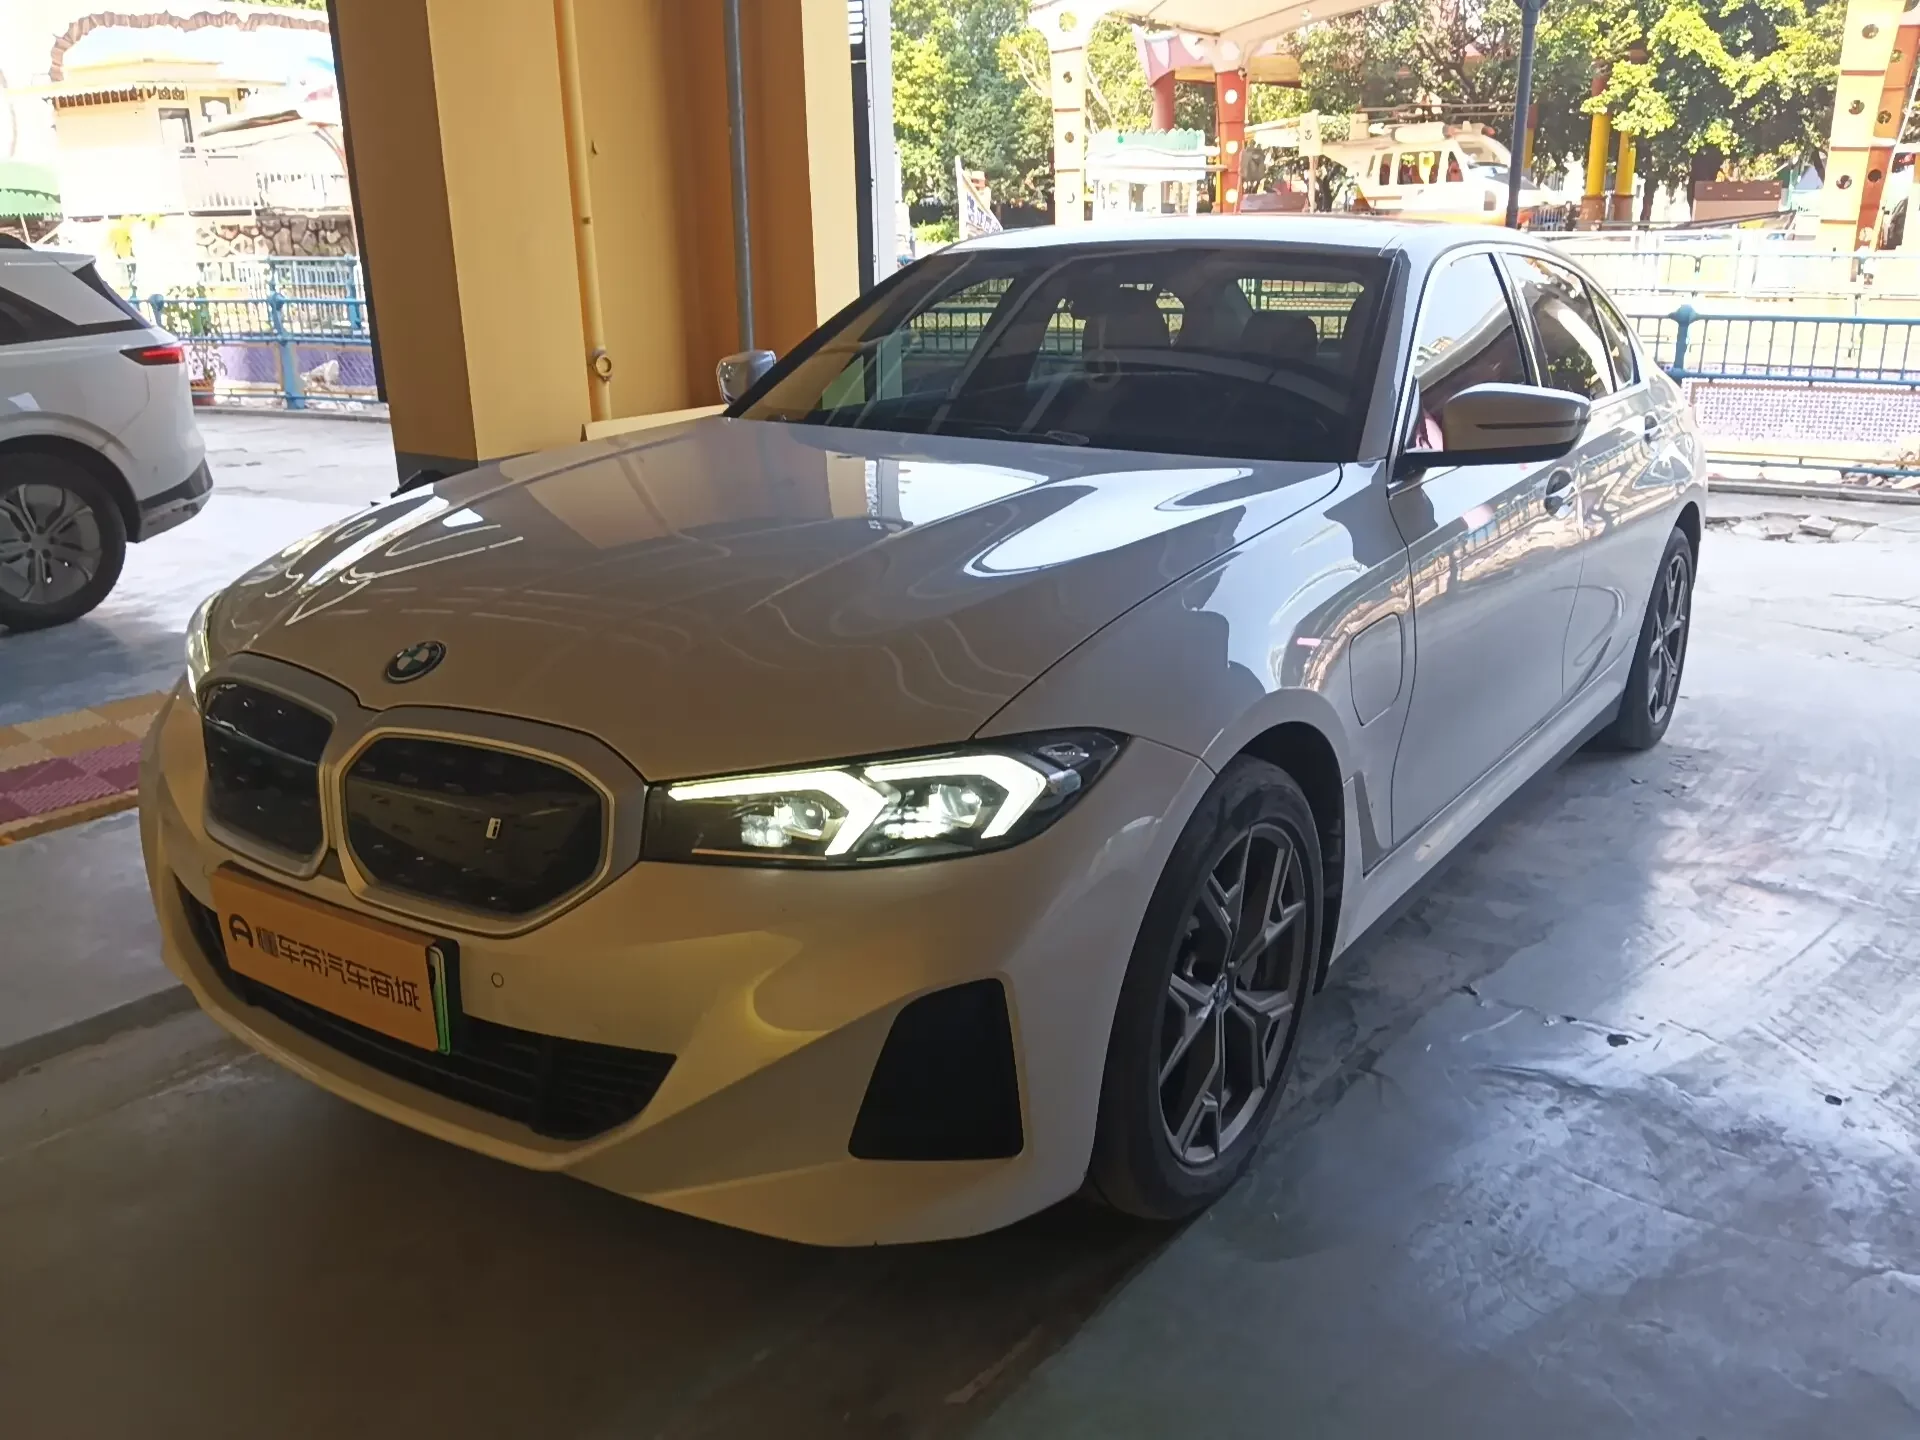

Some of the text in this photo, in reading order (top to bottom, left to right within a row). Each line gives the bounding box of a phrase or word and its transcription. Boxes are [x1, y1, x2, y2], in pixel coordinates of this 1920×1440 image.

[256, 926, 421, 1012] 车帝汽车商城
